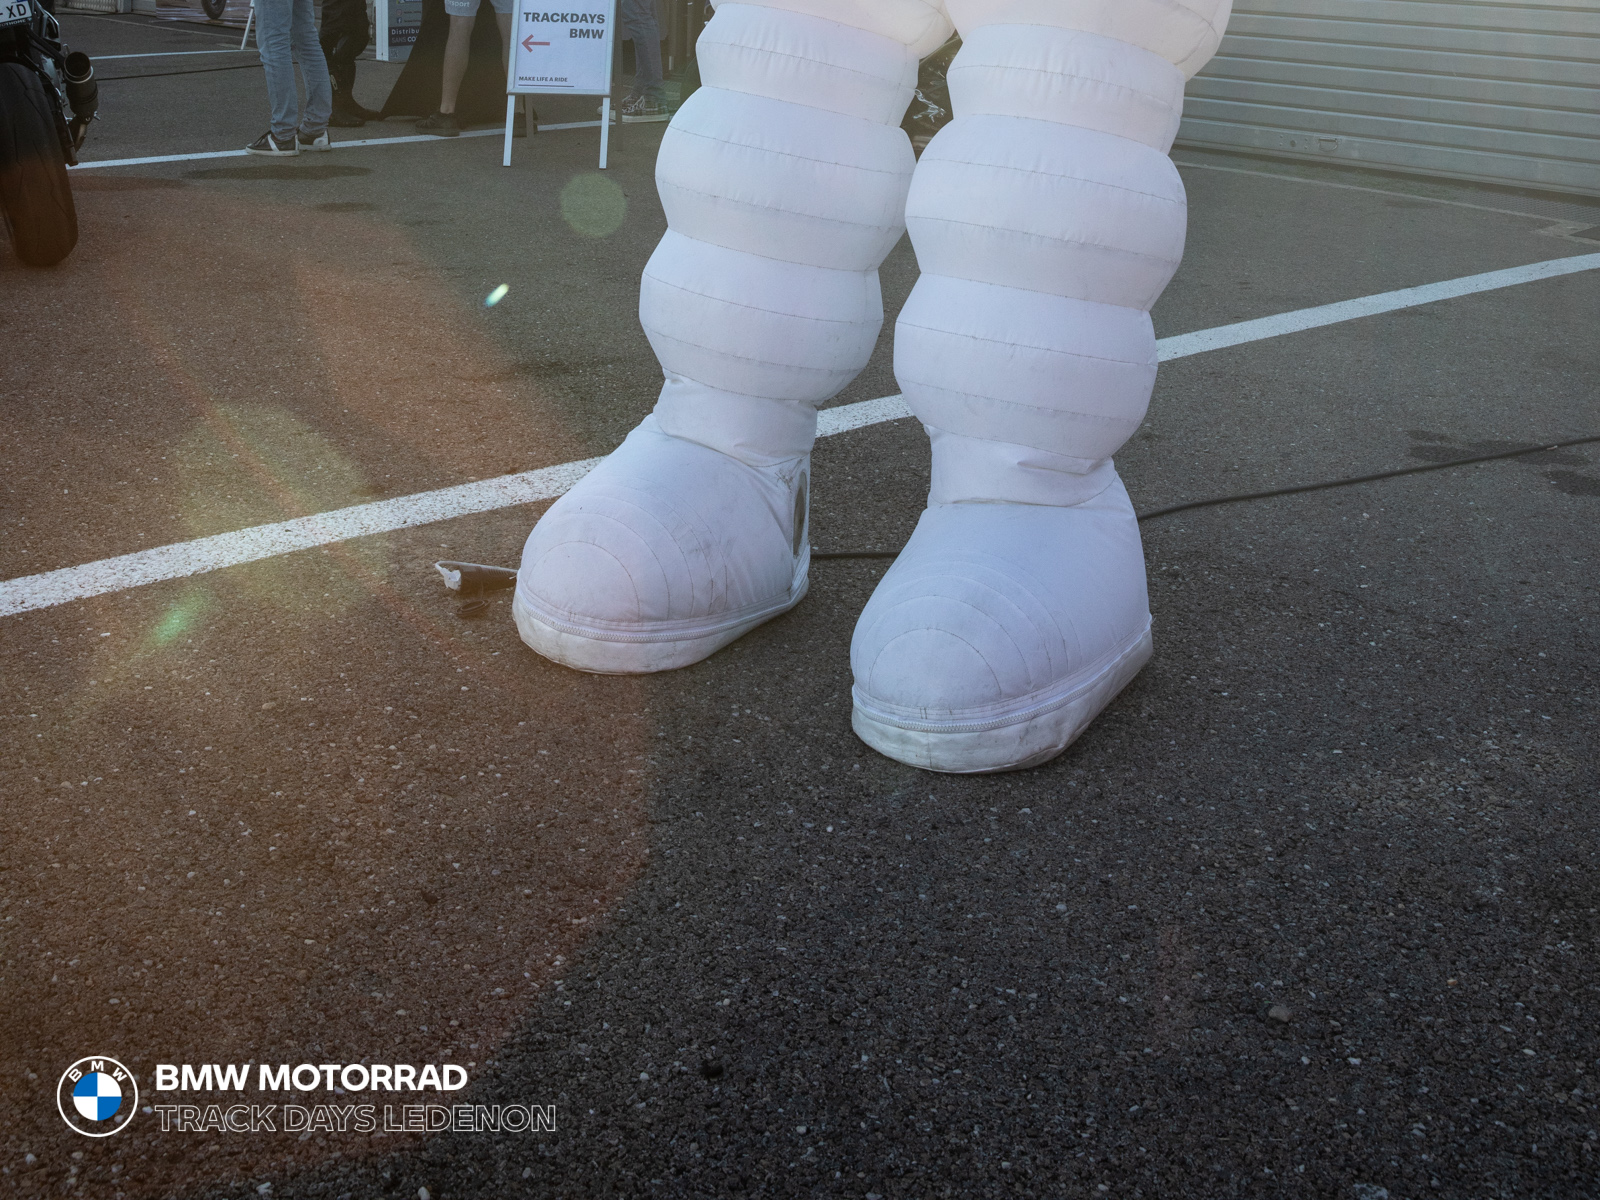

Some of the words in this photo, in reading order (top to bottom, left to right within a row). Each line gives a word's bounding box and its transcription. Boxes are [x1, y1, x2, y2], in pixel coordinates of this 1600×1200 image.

[0, 4, 27, 19] -XD
[523, 12, 605, 24] TRACKDAYS
[407, 35, 417, 43] CO
[569, 28, 604, 39] BMW
